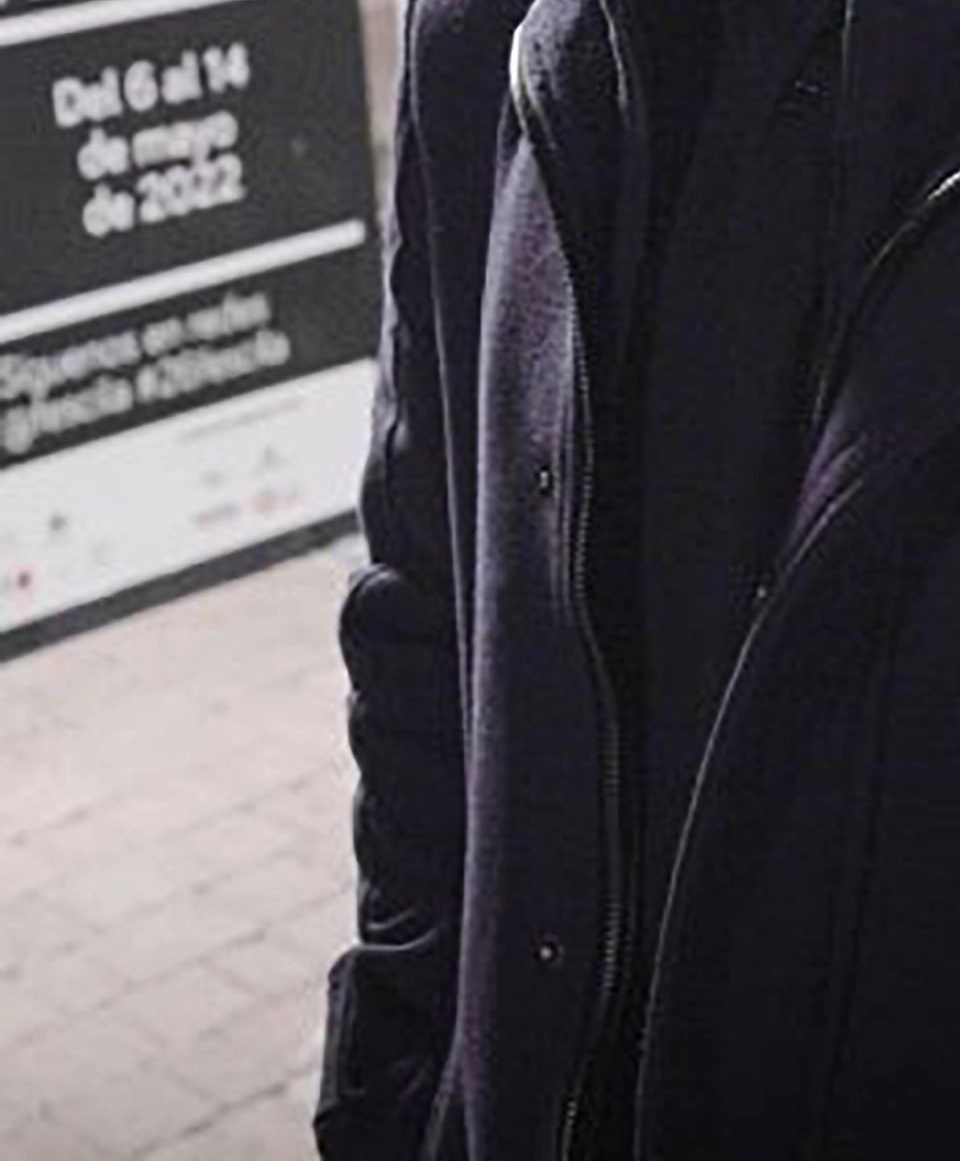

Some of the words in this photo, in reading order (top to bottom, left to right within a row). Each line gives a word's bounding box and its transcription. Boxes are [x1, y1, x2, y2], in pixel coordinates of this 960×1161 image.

[52, 66, 123, 128] Del
[123, 58, 158, 112] 6
[161, 49, 201, 104] al
[203, 42, 249, 92] 14
[76, 127, 129, 180] de
[132, 110, 238, 168] mayo
[82, 183, 135, 237] de
[137, 152, 246, 223] 2022
